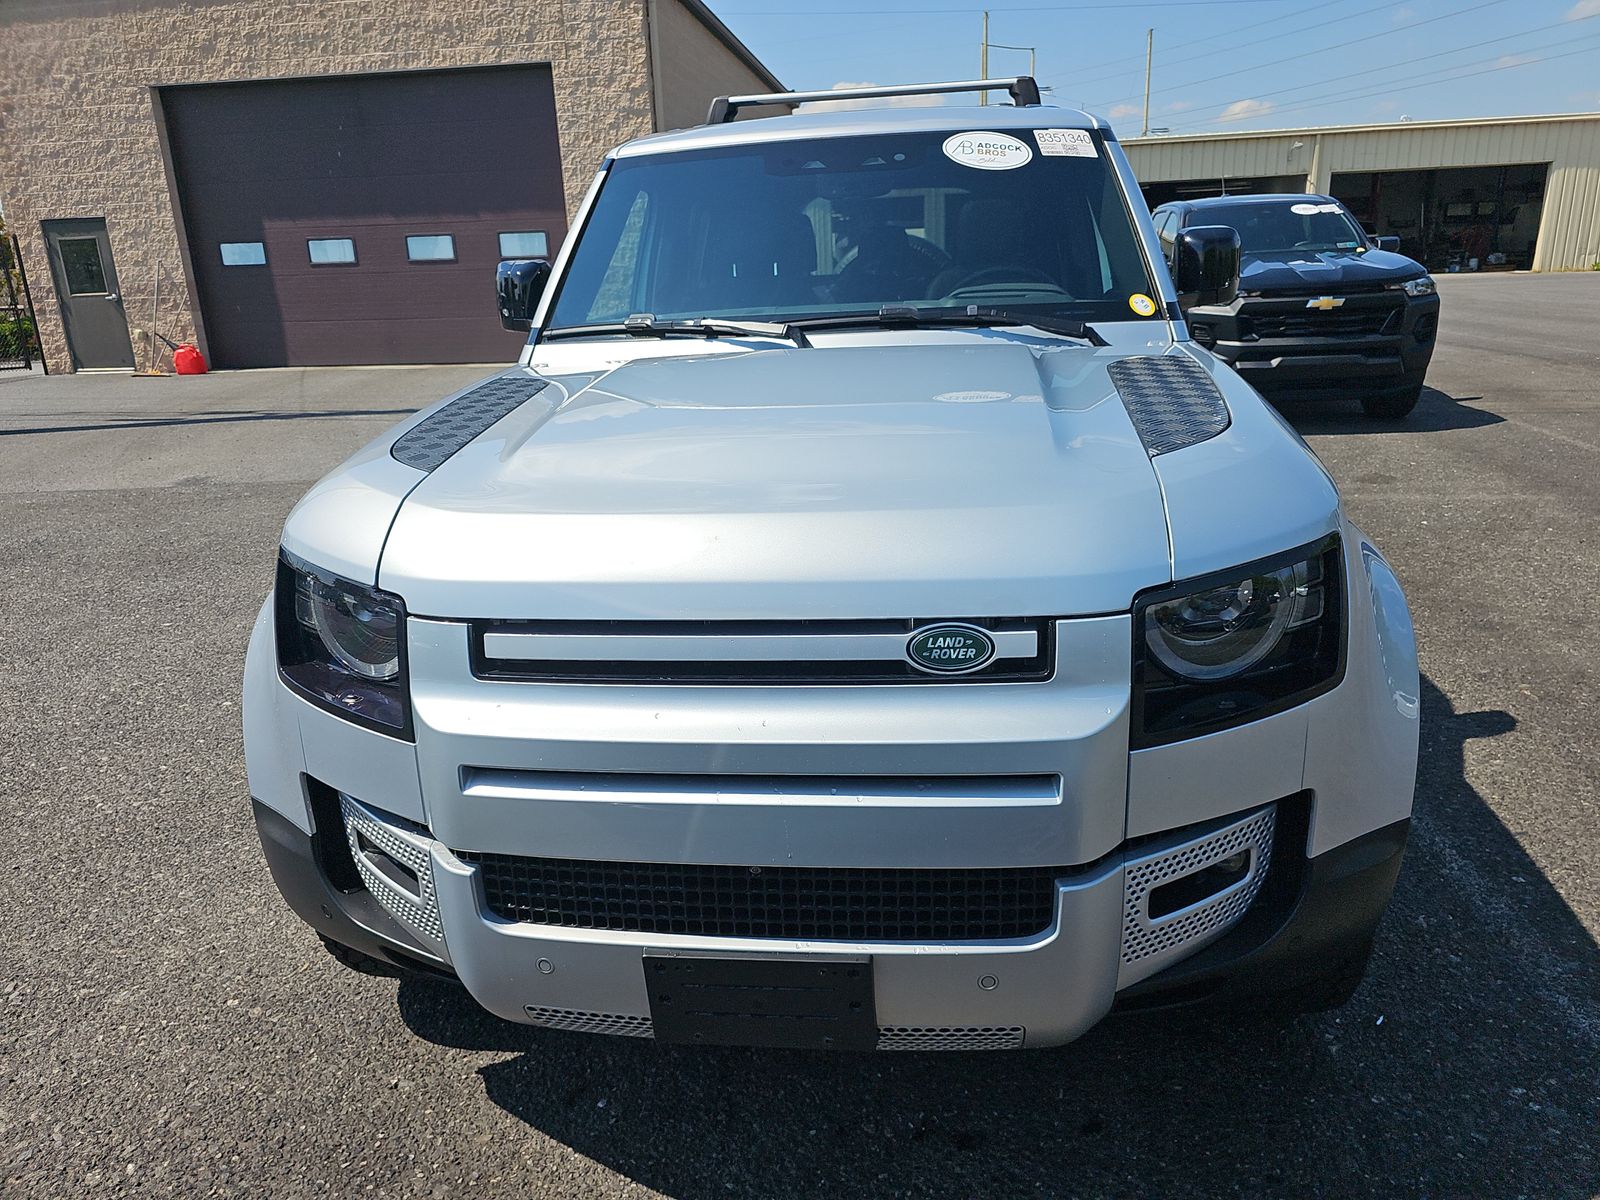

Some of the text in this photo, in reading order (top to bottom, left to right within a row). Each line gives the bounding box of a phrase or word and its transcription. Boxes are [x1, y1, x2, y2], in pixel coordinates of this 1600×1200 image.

[1037, 132, 1091, 144] 8351340
[977, 142, 1022, 152] ADCOCK
[977, 149, 1007, 157] BROS
[927, 637, 964, 648] LAND
[931, 648, 976, 659] ROVER
